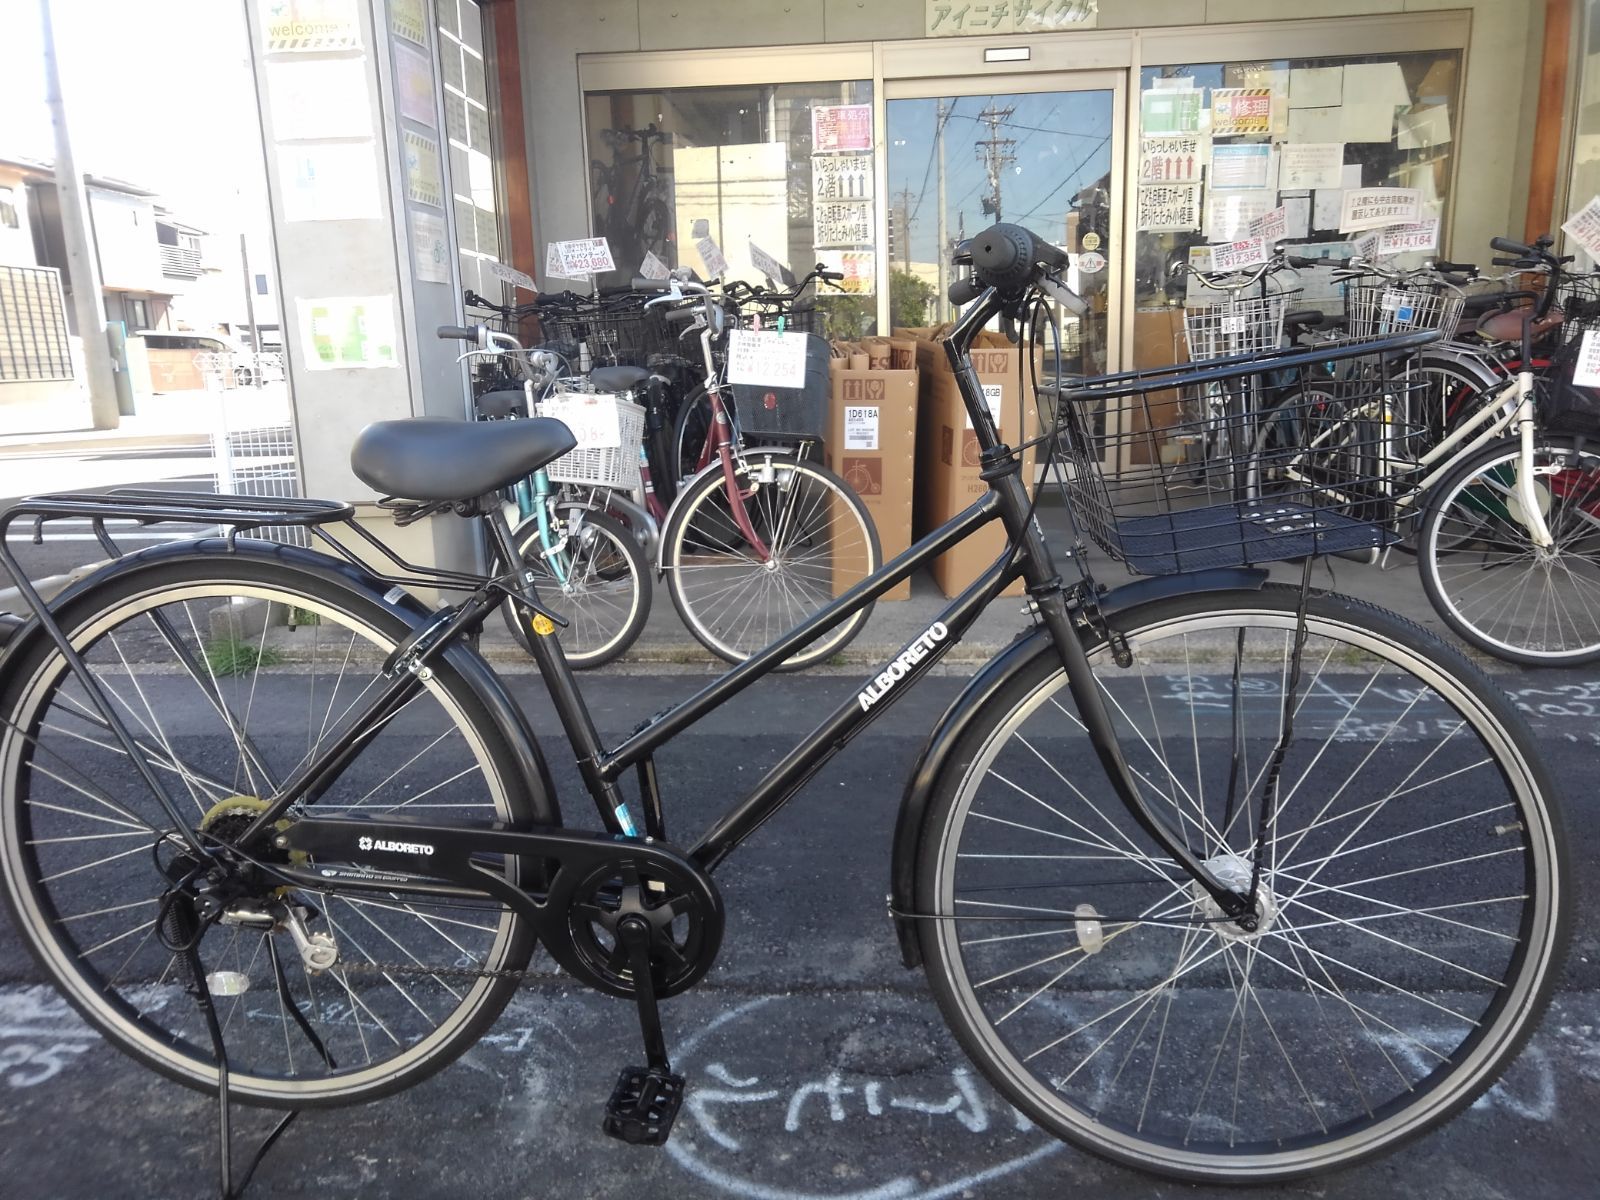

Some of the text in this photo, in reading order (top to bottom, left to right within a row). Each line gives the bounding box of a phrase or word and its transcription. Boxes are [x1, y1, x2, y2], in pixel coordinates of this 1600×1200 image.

[931, 0, 1092, 31] アイニチサイクル
[1235, 98, 1268, 117] 修理
[1142, 139, 1196, 154] いらっしゃいませ
[814, 157, 867, 172] いらっしゃいませ
[1143, 156, 1163, 180] 2階
[817, 173, 836, 198] 2階
[858, 621, 948, 712] ALBORETO
[374, 840, 435, 856] ALBORETO
